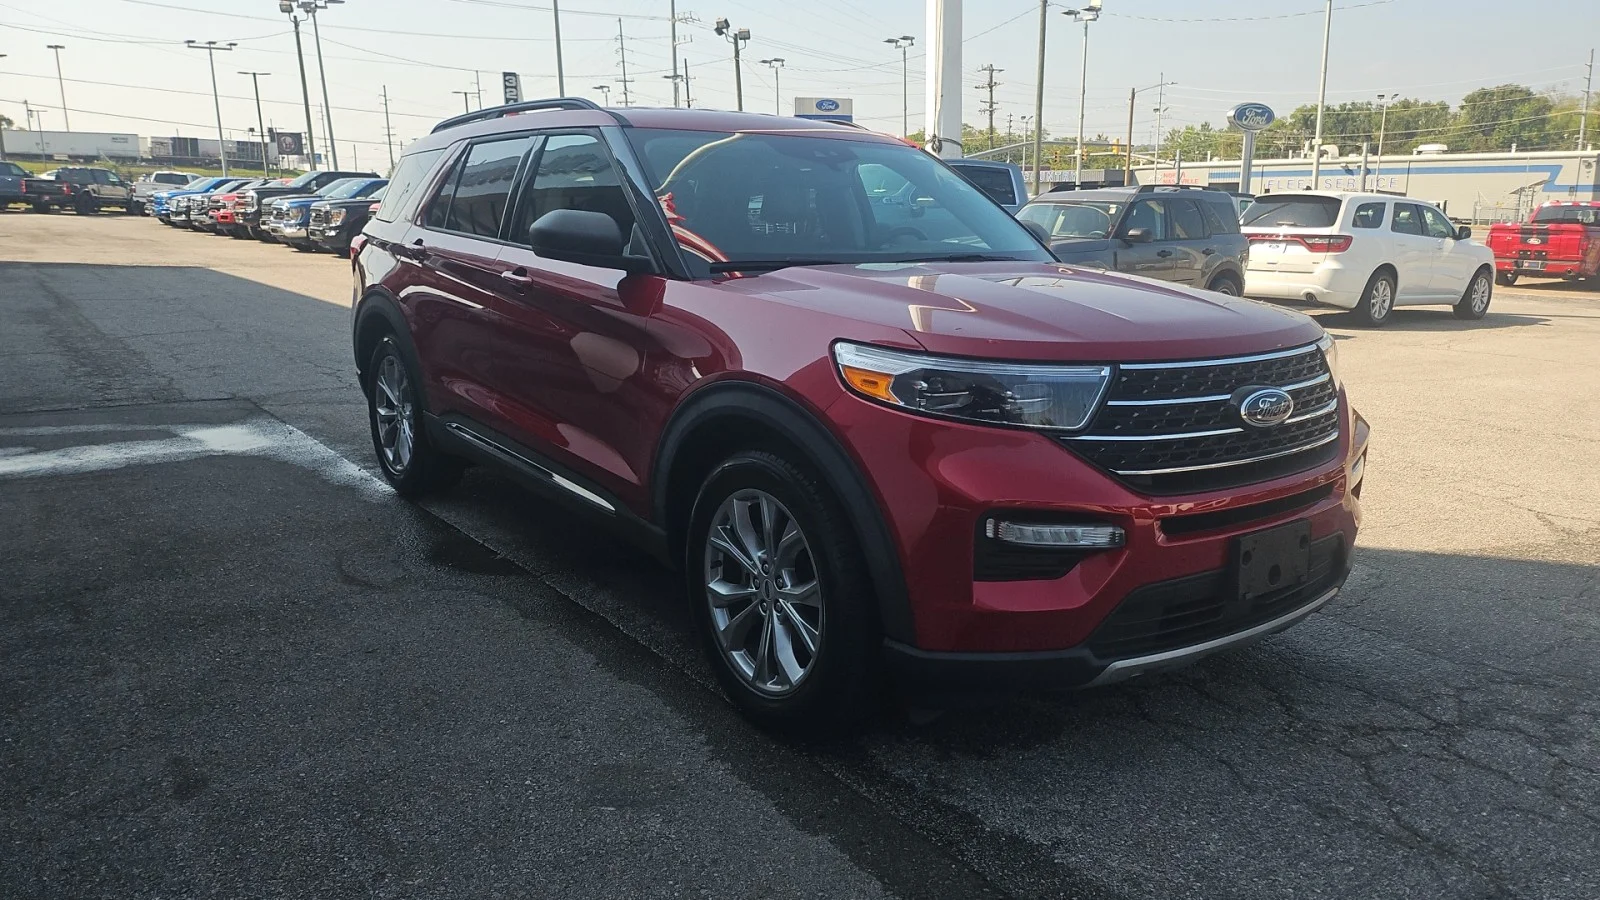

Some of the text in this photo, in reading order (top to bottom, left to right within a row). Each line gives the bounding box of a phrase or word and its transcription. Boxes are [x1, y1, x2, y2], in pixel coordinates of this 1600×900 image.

[1243, 108, 1269, 125] Ford
[1324, 177, 1398, 189] SERICE
[1257, 397, 1290, 418] Ford
